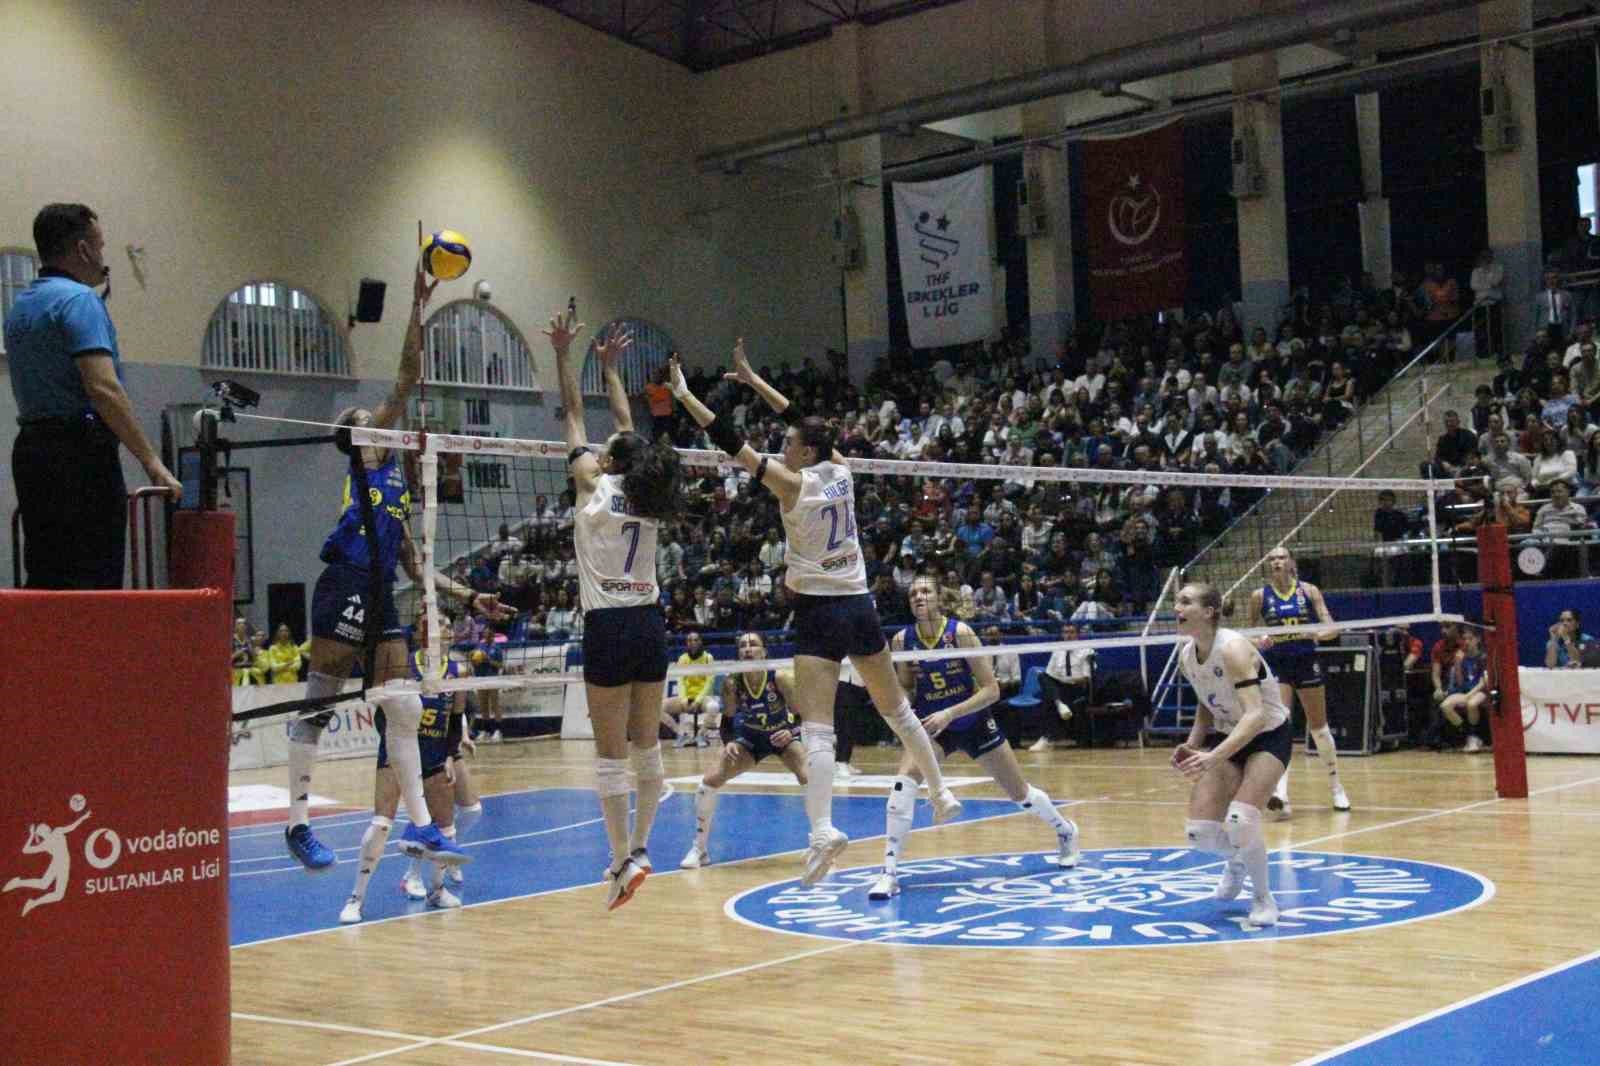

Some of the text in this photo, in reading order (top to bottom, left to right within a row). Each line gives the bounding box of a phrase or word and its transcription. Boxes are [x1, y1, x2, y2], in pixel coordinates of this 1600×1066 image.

[907, 282, 980, 303] ERKEKLER
[621, 521, 640, 575] 7
[342, 605, 364, 623] 44
[929, 672, 946, 689] 5
[1544, 703, 1600, 725] TVF
[127, 827, 220, 853] vodafone
[85, 867, 184, 894] SULTANLAR
